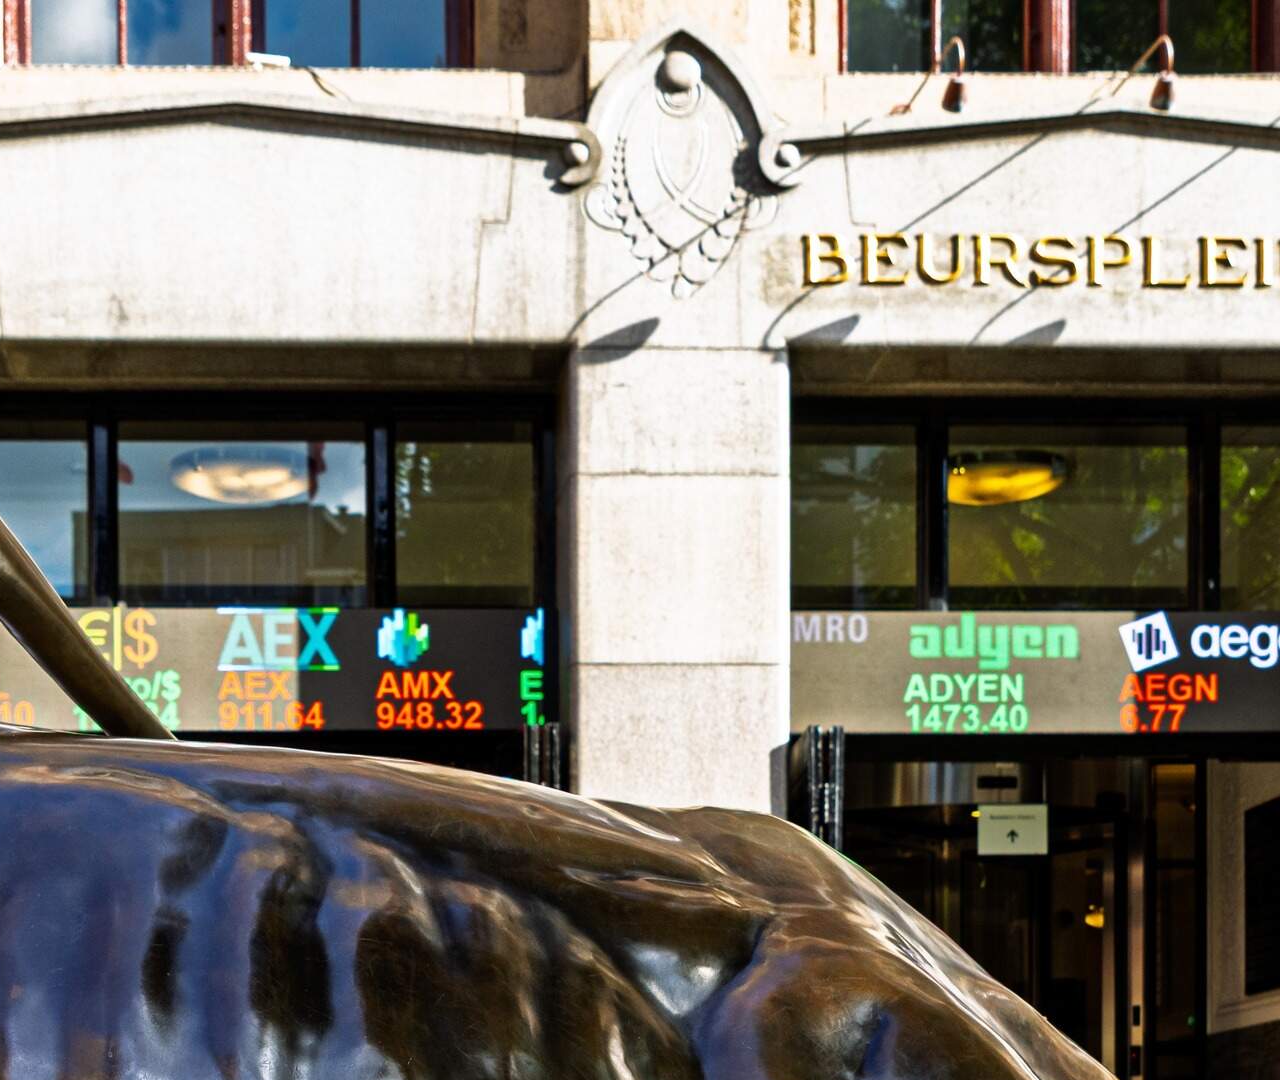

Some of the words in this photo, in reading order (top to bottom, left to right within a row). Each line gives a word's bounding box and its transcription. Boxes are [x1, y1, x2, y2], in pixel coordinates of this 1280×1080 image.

[217, 606, 340, 672] AEX
[909, 610, 1080, 671] adyen
[219, 671, 292, 700] AEX
[376, 670, 455, 699] AMX
[903, 673, 1025, 703] ADYEN
[1119, 672, 1219, 702] AEGN
[219, 700, 326, 731] 911.64
[376, 701, 483, 730] 948.32
[905, 703, 1029, 734] 1473.40
[1119, 703, 1187, 733] 6.77
